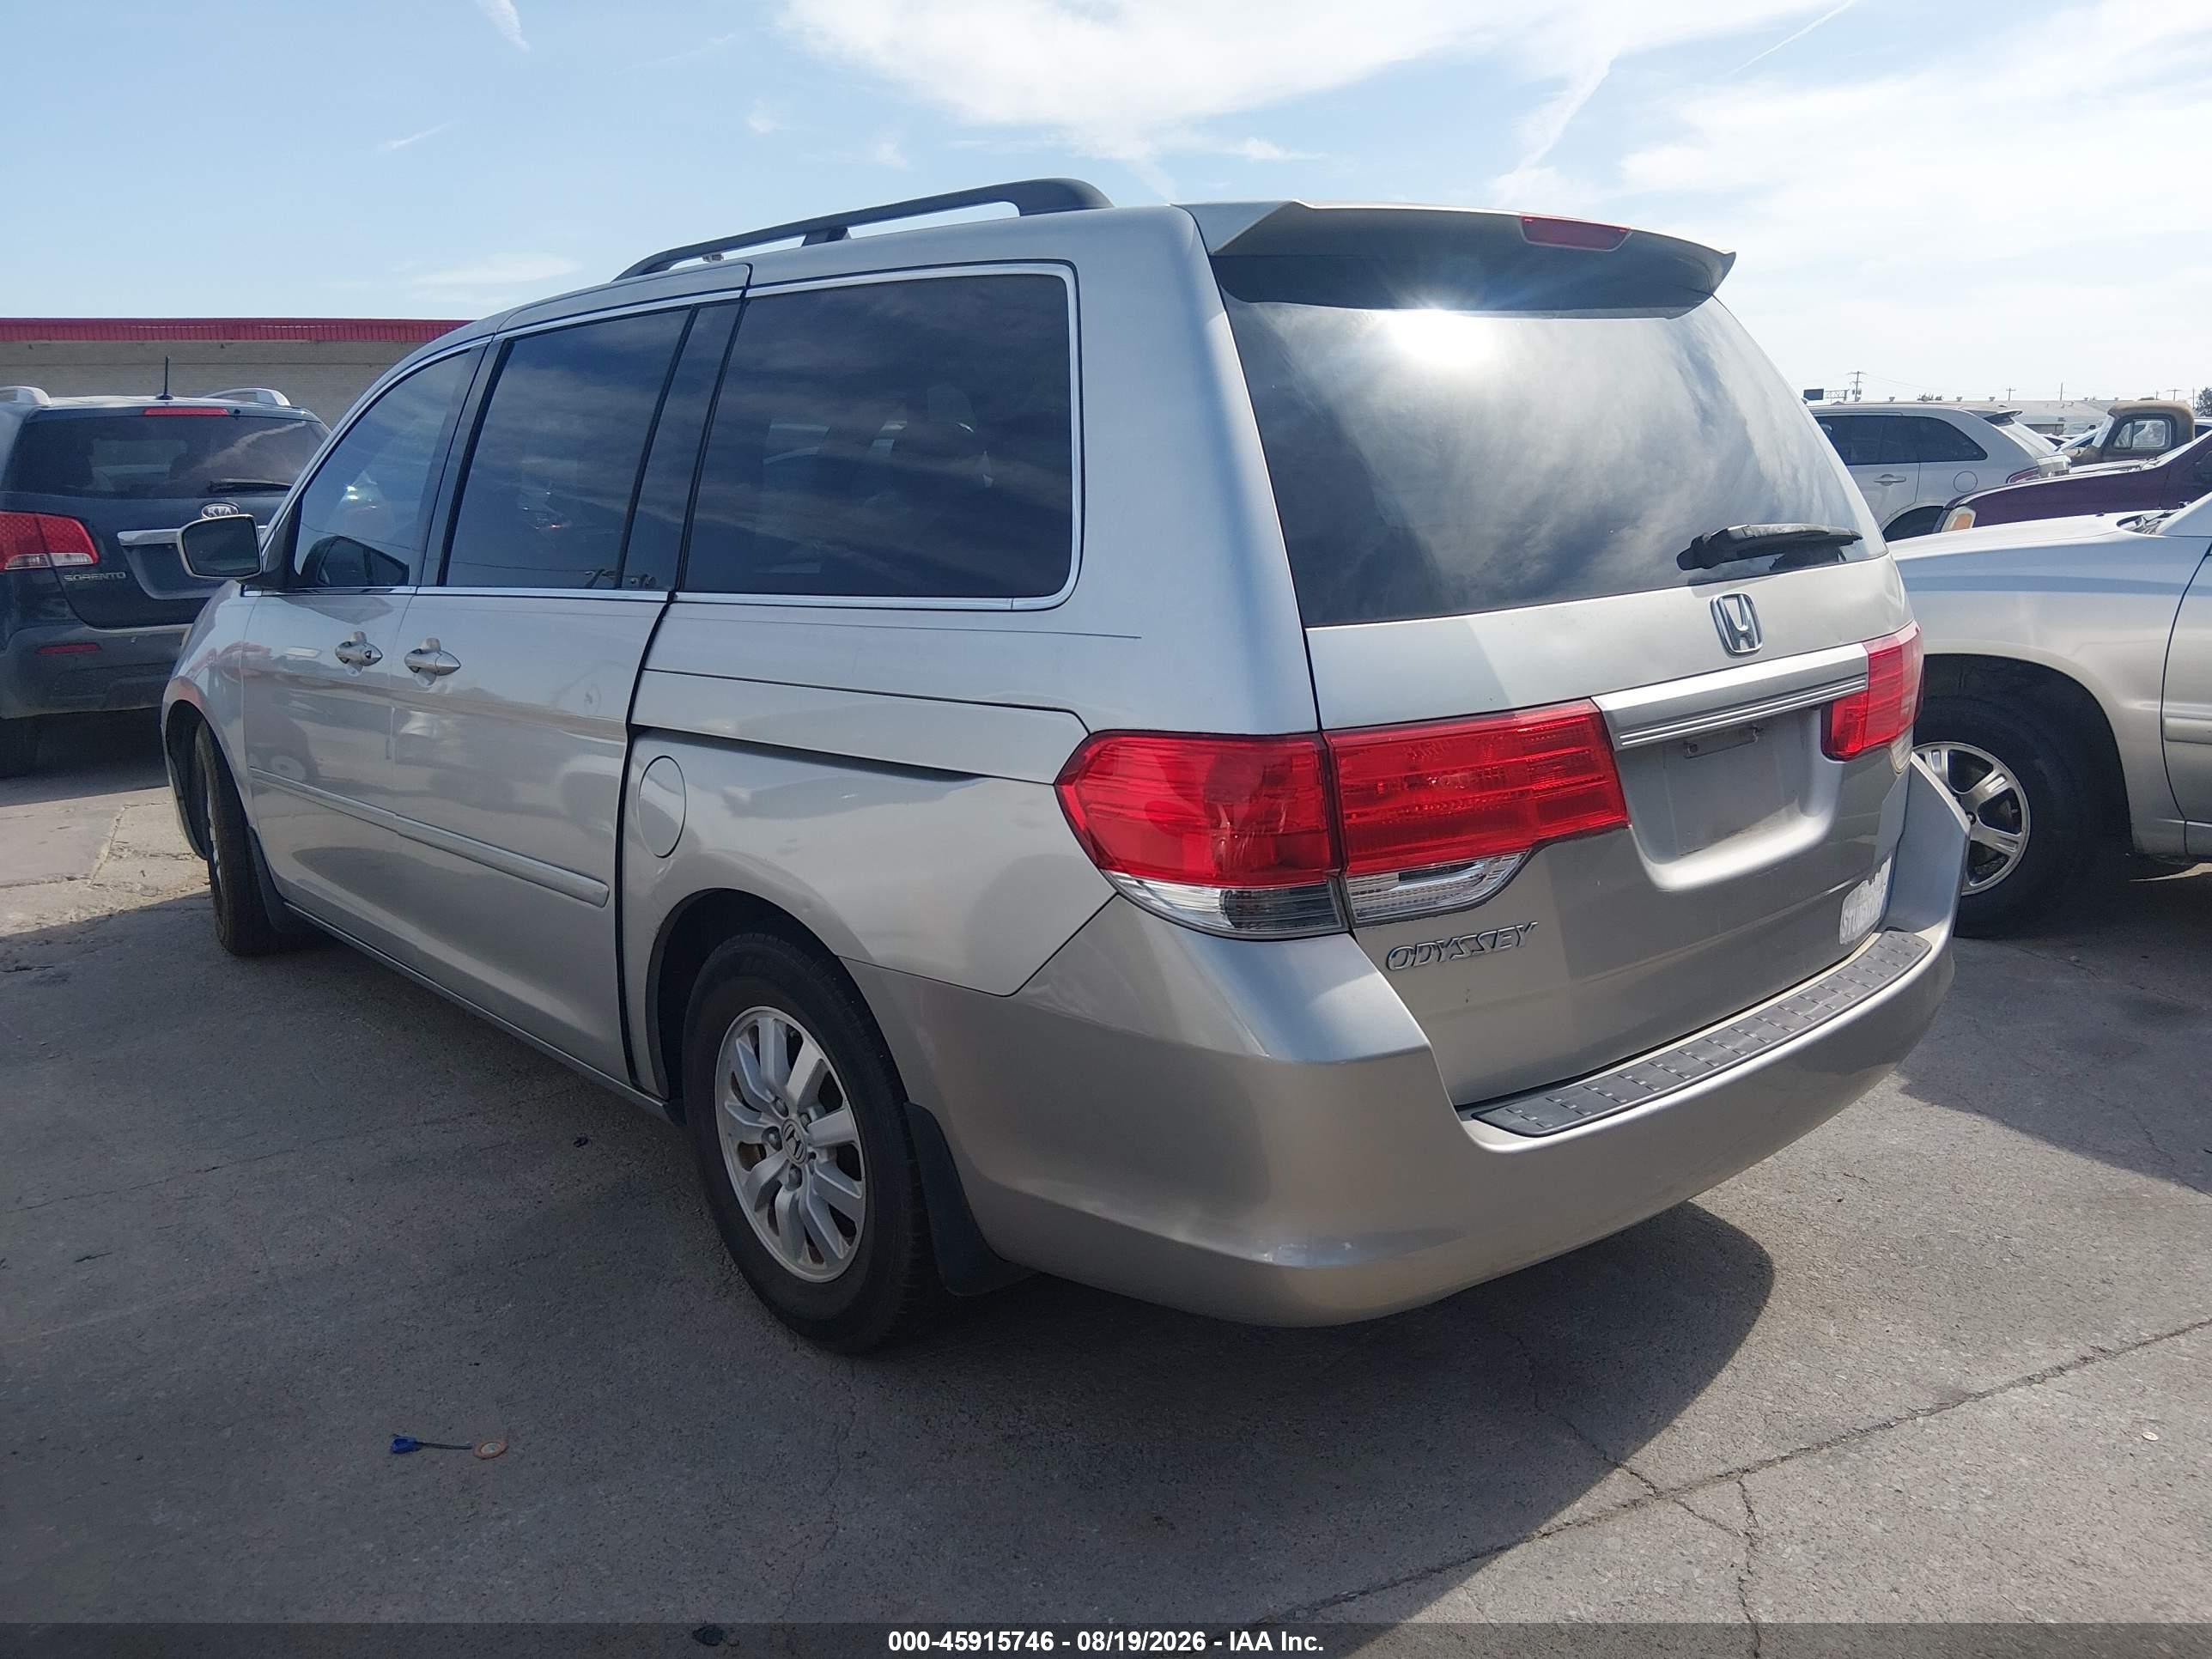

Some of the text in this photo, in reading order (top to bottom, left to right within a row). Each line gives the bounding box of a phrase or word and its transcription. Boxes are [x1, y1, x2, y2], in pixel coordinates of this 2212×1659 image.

[207, 505, 233, 517] KIA
[64, 571, 126, 581] SORENTO
[1386, 921, 1539, 971] ODYSSEY
